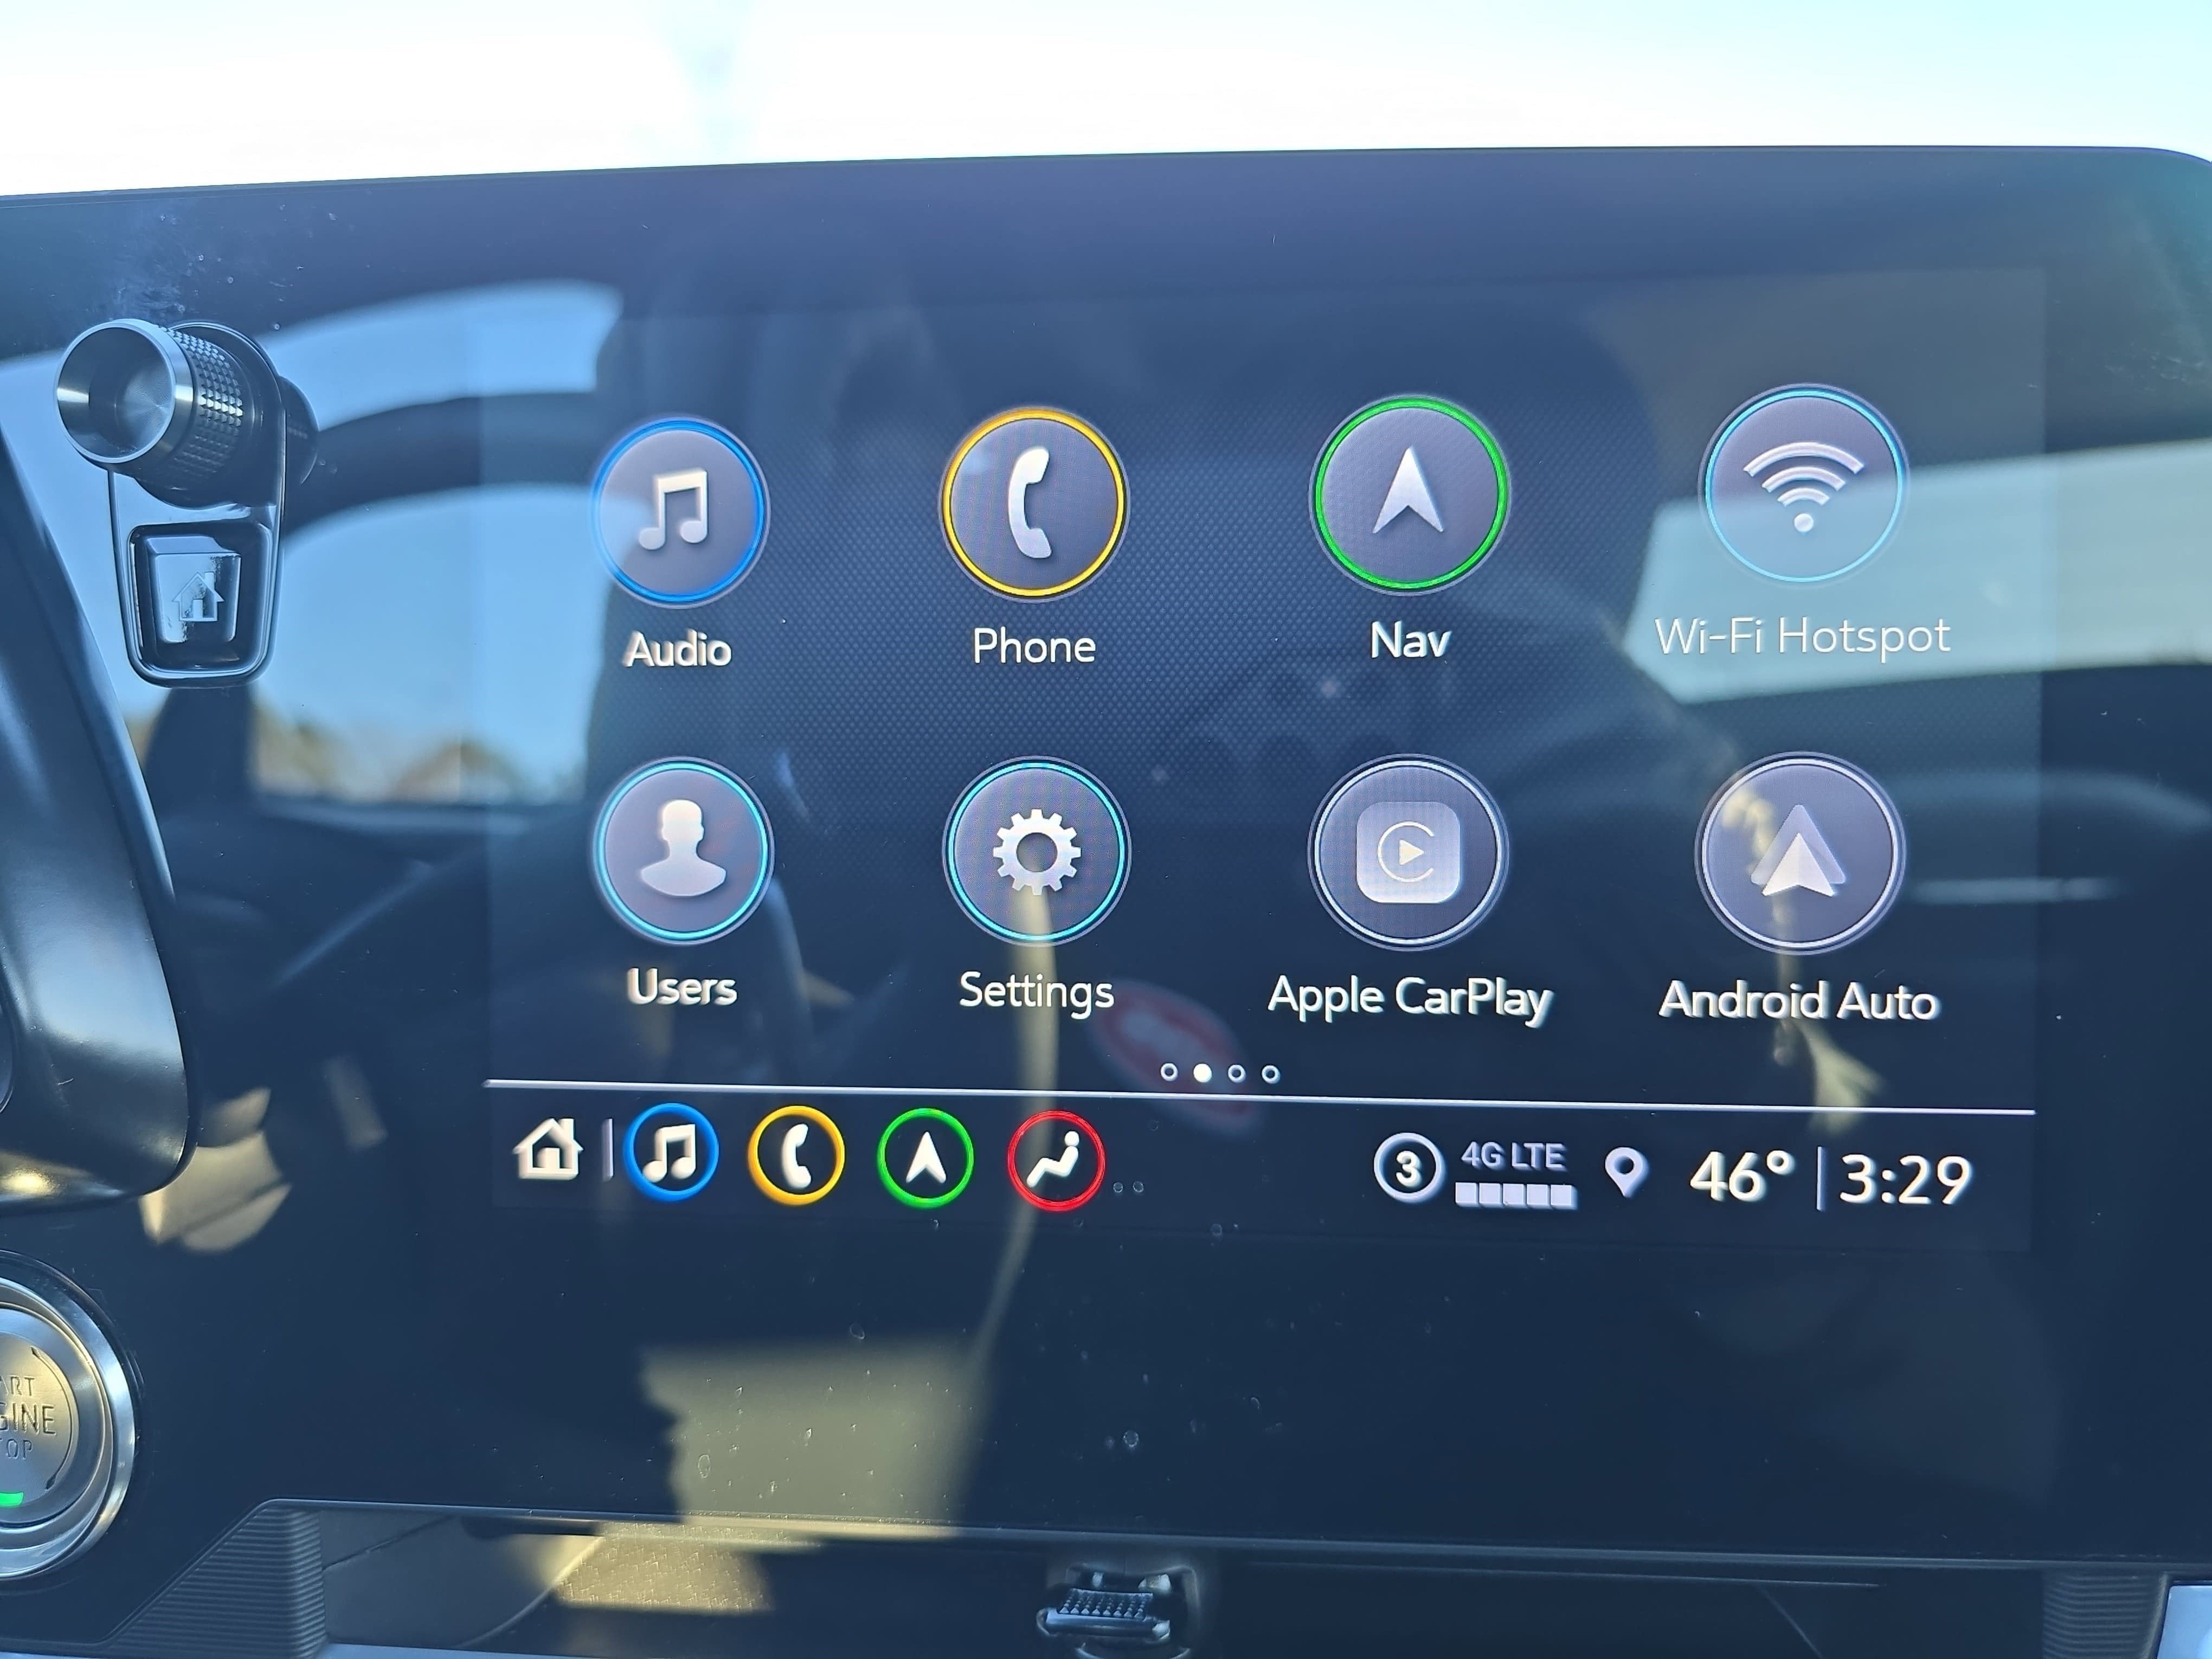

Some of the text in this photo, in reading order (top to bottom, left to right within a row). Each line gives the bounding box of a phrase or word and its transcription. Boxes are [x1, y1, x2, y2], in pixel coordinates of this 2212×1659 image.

[625, 629, 732, 667] Audio
[974, 626, 1096, 664] Phone
[1371, 621, 1452, 658] Nav
[1654, 616, 1951, 664] Wi-Fi Hotspot
[627, 967, 738, 1006] Users
[959, 970, 1115, 1020] Settings
[1268, 974, 1554, 1028] Apple CarPlay
[1658, 979, 1941, 1020] Android Auto
[1396, 1150, 1422, 1187] 3
[1461, 1141, 1566, 1171] 4G LTE
[1689, 1149, 1796, 1202] 46°
[1840, 1153, 1972, 1205] 3:29
